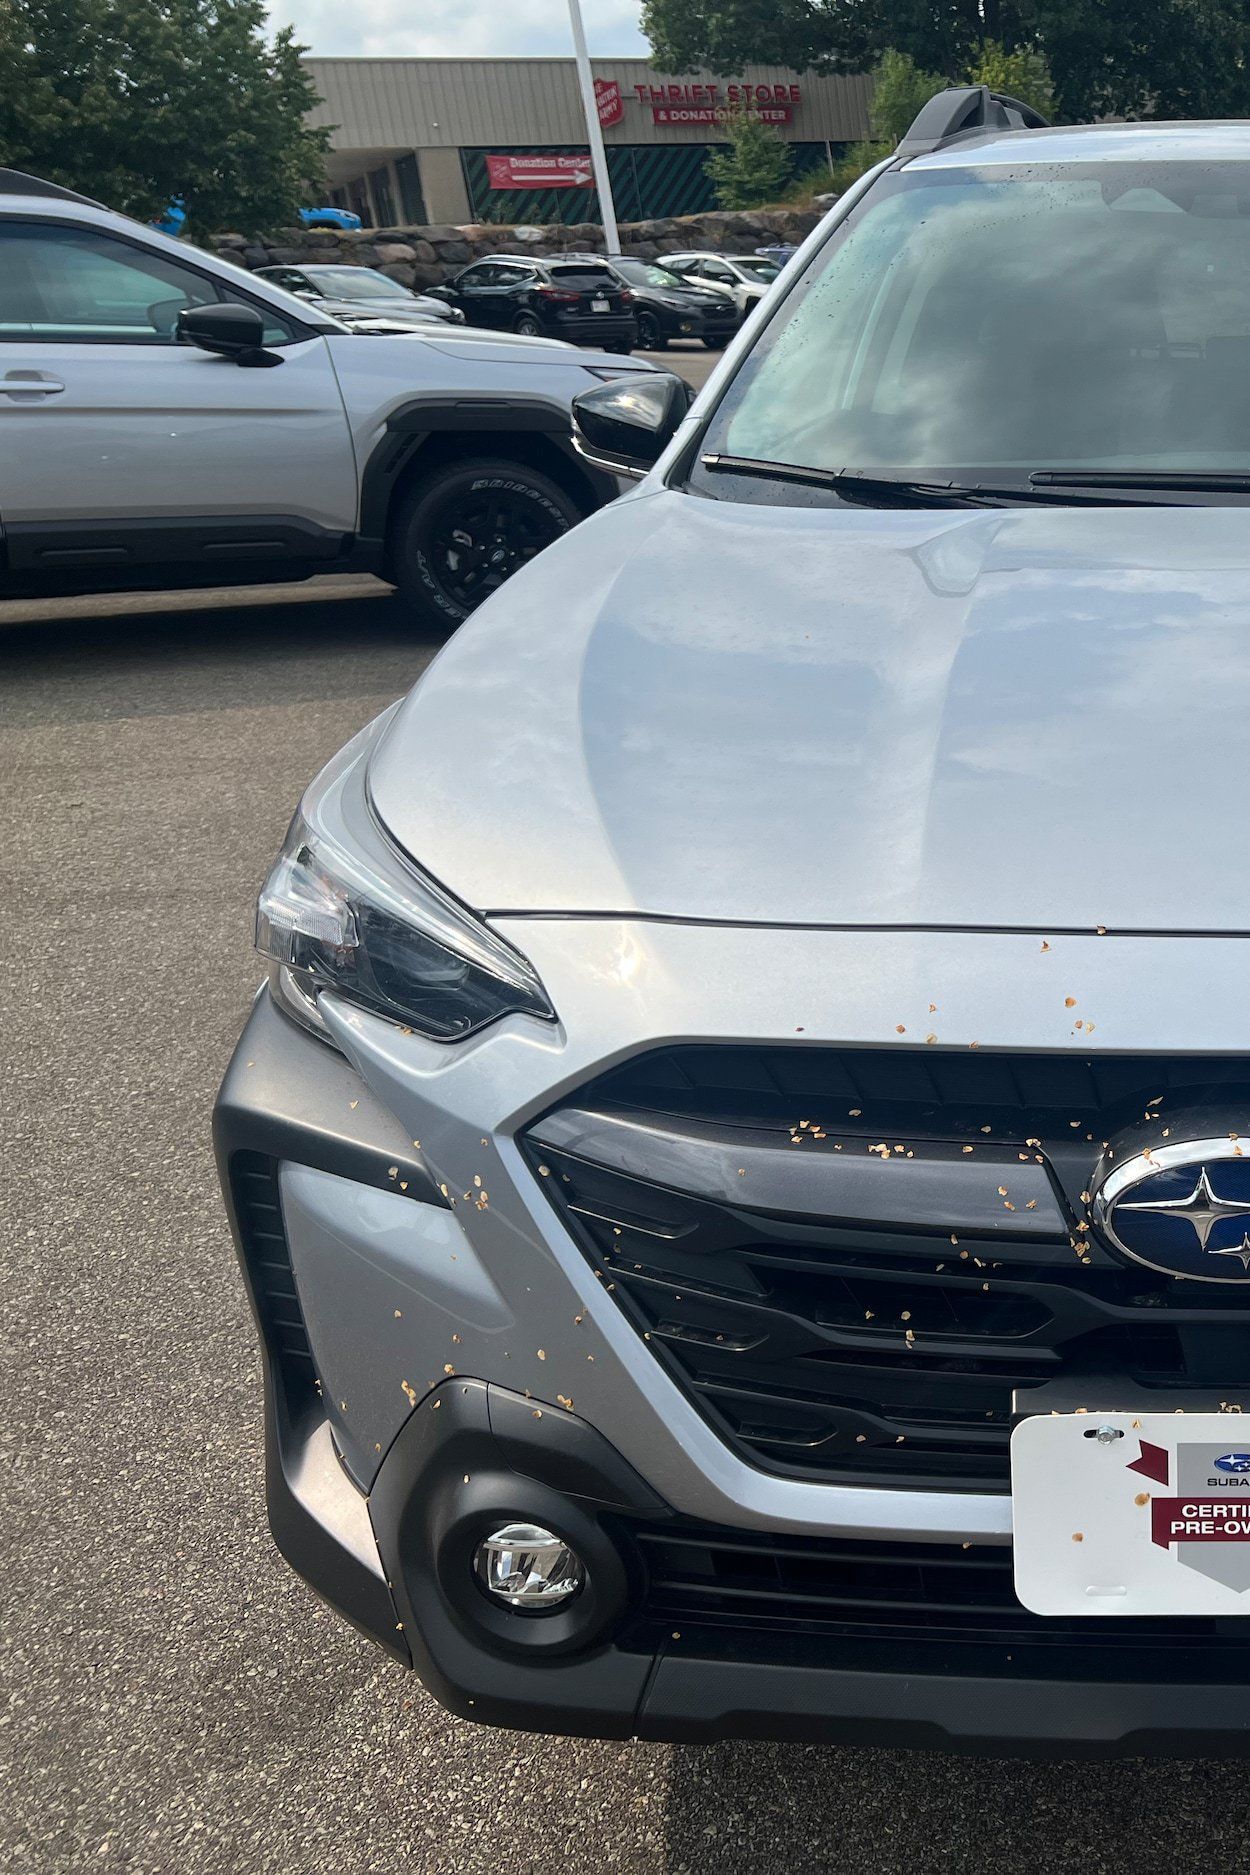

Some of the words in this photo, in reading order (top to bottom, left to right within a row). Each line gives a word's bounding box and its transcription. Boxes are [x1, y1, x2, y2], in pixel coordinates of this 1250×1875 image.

[634, 85, 717, 103] THRIFT
[727, 85, 801, 103] STORE
[658, 110, 668, 120] &
[670, 110, 736, 121] DONATION
[510, 157, 556, 168] Donation
